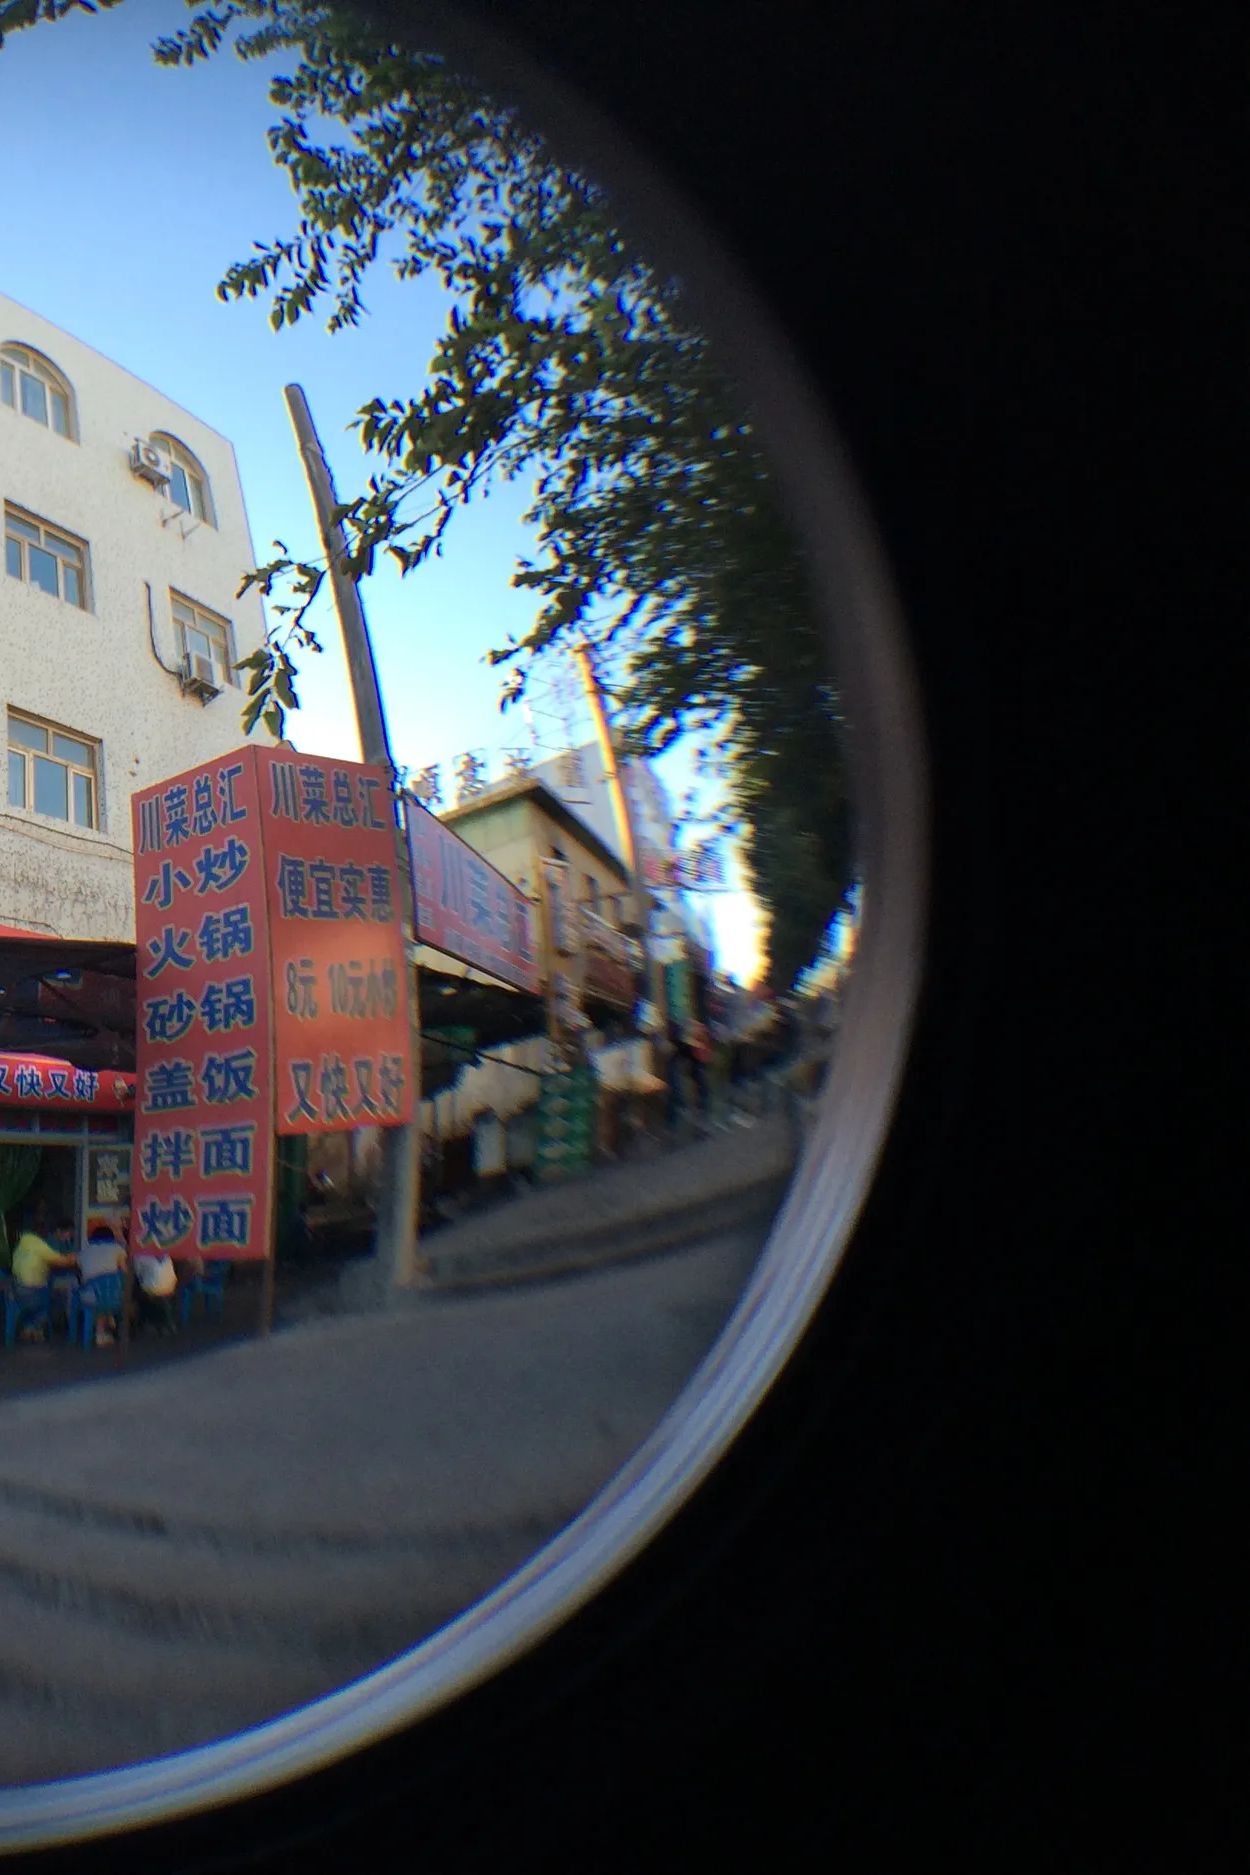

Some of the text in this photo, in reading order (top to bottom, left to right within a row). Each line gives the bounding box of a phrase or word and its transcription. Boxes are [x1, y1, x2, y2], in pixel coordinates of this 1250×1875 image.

[139, 763, 248, 856] 川菜总汇
[268, 760, 388, 831] 川菜总汇
[141, 834, 251, 910] 小炒
[275, 852, 396, 924] 便宜实惠
[142, 902, 255, 981] 火锅
[142, 974, 258, 1045] 砂锅
[142, 1046, 259, 1115] 盖饭
[285, 1052, 406, 1125] 又快又好
[141, 1120, 257, 1181] 拌面
[137, 1191, 255, 1250] 炒面
